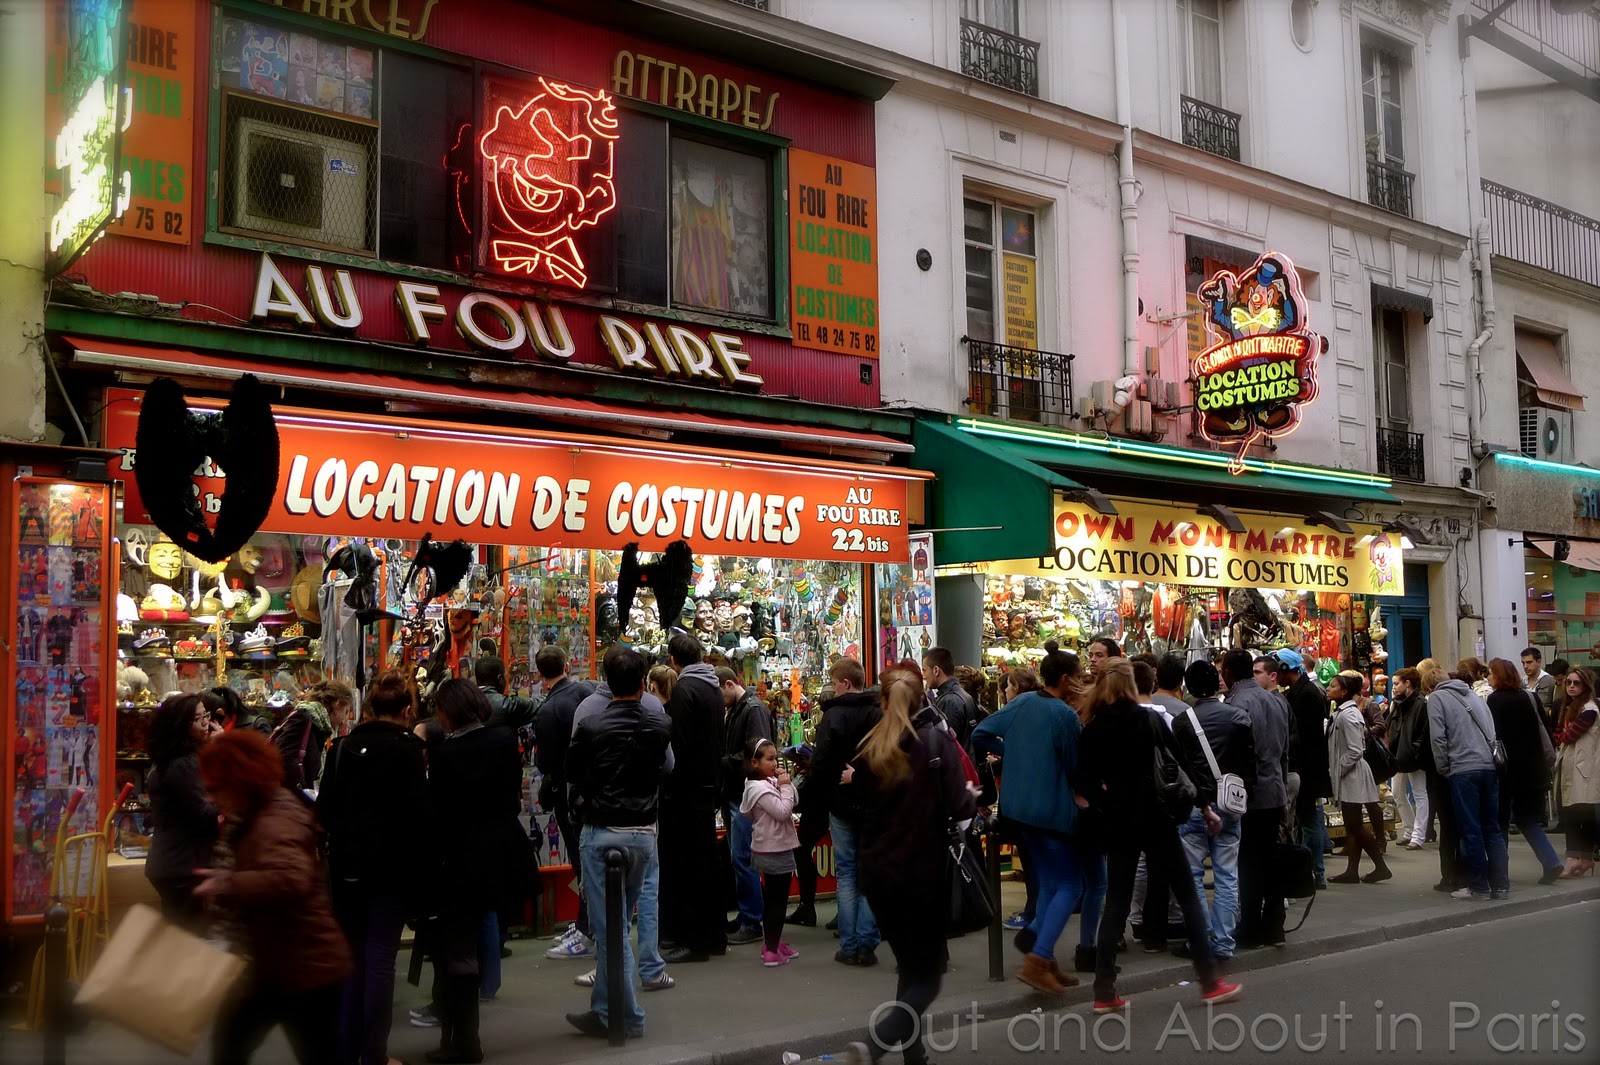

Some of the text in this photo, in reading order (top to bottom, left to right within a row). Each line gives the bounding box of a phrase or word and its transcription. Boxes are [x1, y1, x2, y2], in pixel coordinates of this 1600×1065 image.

[611, 49, 780, 131] ATTRAPES
[825, 164, 842, 186] AU
[136, 206, 183, 235] 75 82
[799, 184, 868, 228] FOU RIRE
[797, 220, 872, 264] LOCATION
[827, 263, 843, 286] DE
[249, 251, 765, 388] AU FOU RIRE
[795, 285, 875, 327] COSTUMES
[797, 322, 876, 352] TEL 48 24 75 82
[1198, 359, 1296, 392] LOCATION
[1198, 378, 1300, 410] COSTUMES
[285, 453, 521, 528] LOCATION
[530, 475, 591, 532] DE
[607, 479, 805, 545] COSTUMES
[845, 487, 873, 505] AU
[816, 503, 901, 527] FOU RIRE
[831, 528, 890, 553] 22 bis
[1056, 511, 1357, 560] OWN MONTMARTRE
[1186, 555, 1219, 579] DE
[1227, 558, 1349, 587] COSTUMES
